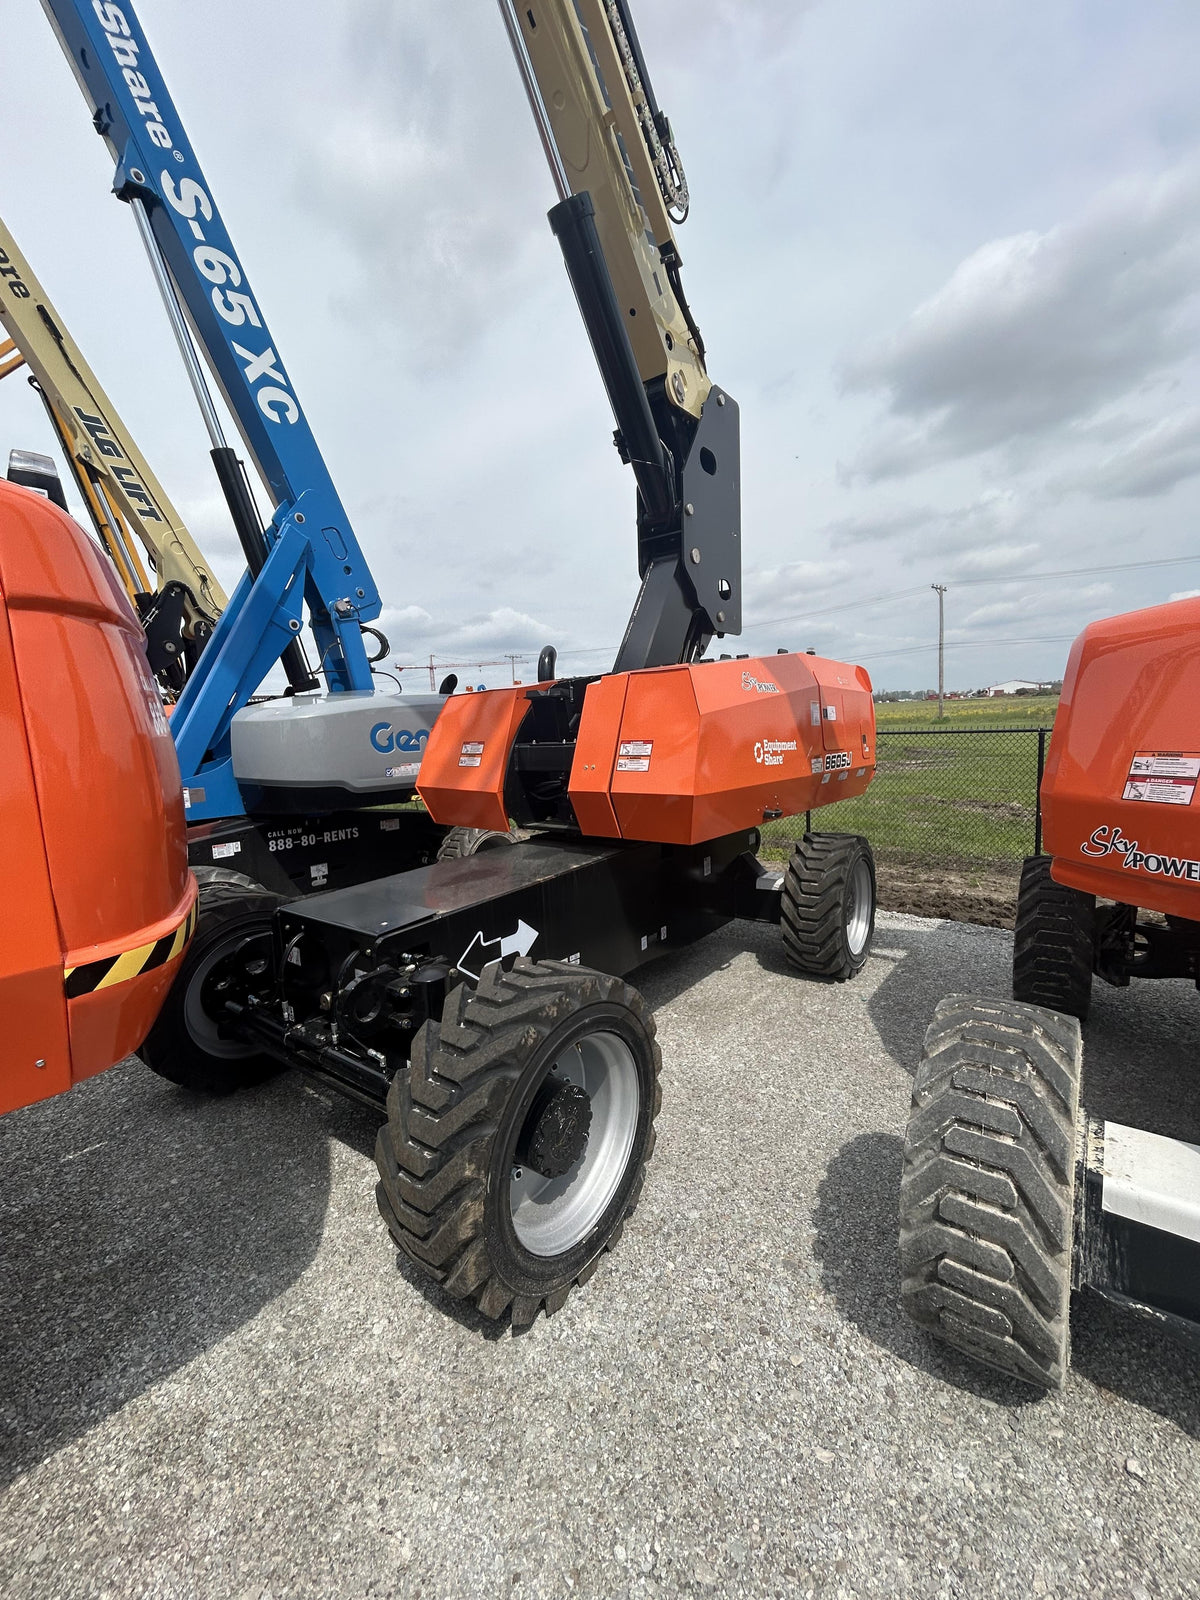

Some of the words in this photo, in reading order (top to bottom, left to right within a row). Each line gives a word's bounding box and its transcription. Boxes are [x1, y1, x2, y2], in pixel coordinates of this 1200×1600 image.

[160, 169, 263, 328] S-65
[231, 340, 300, 425] XC
[71, 405, 125, 459] JLG
[108, 464, 164, 522] LIFT
[763, 739, 797, 754] Equipment
[764, 753, 784, 765] Share
[267, 830, 286, 838] CALL
[287, 827, 303, 835] NOW
[268, 827, 360, 852] 888-80-RENTS
